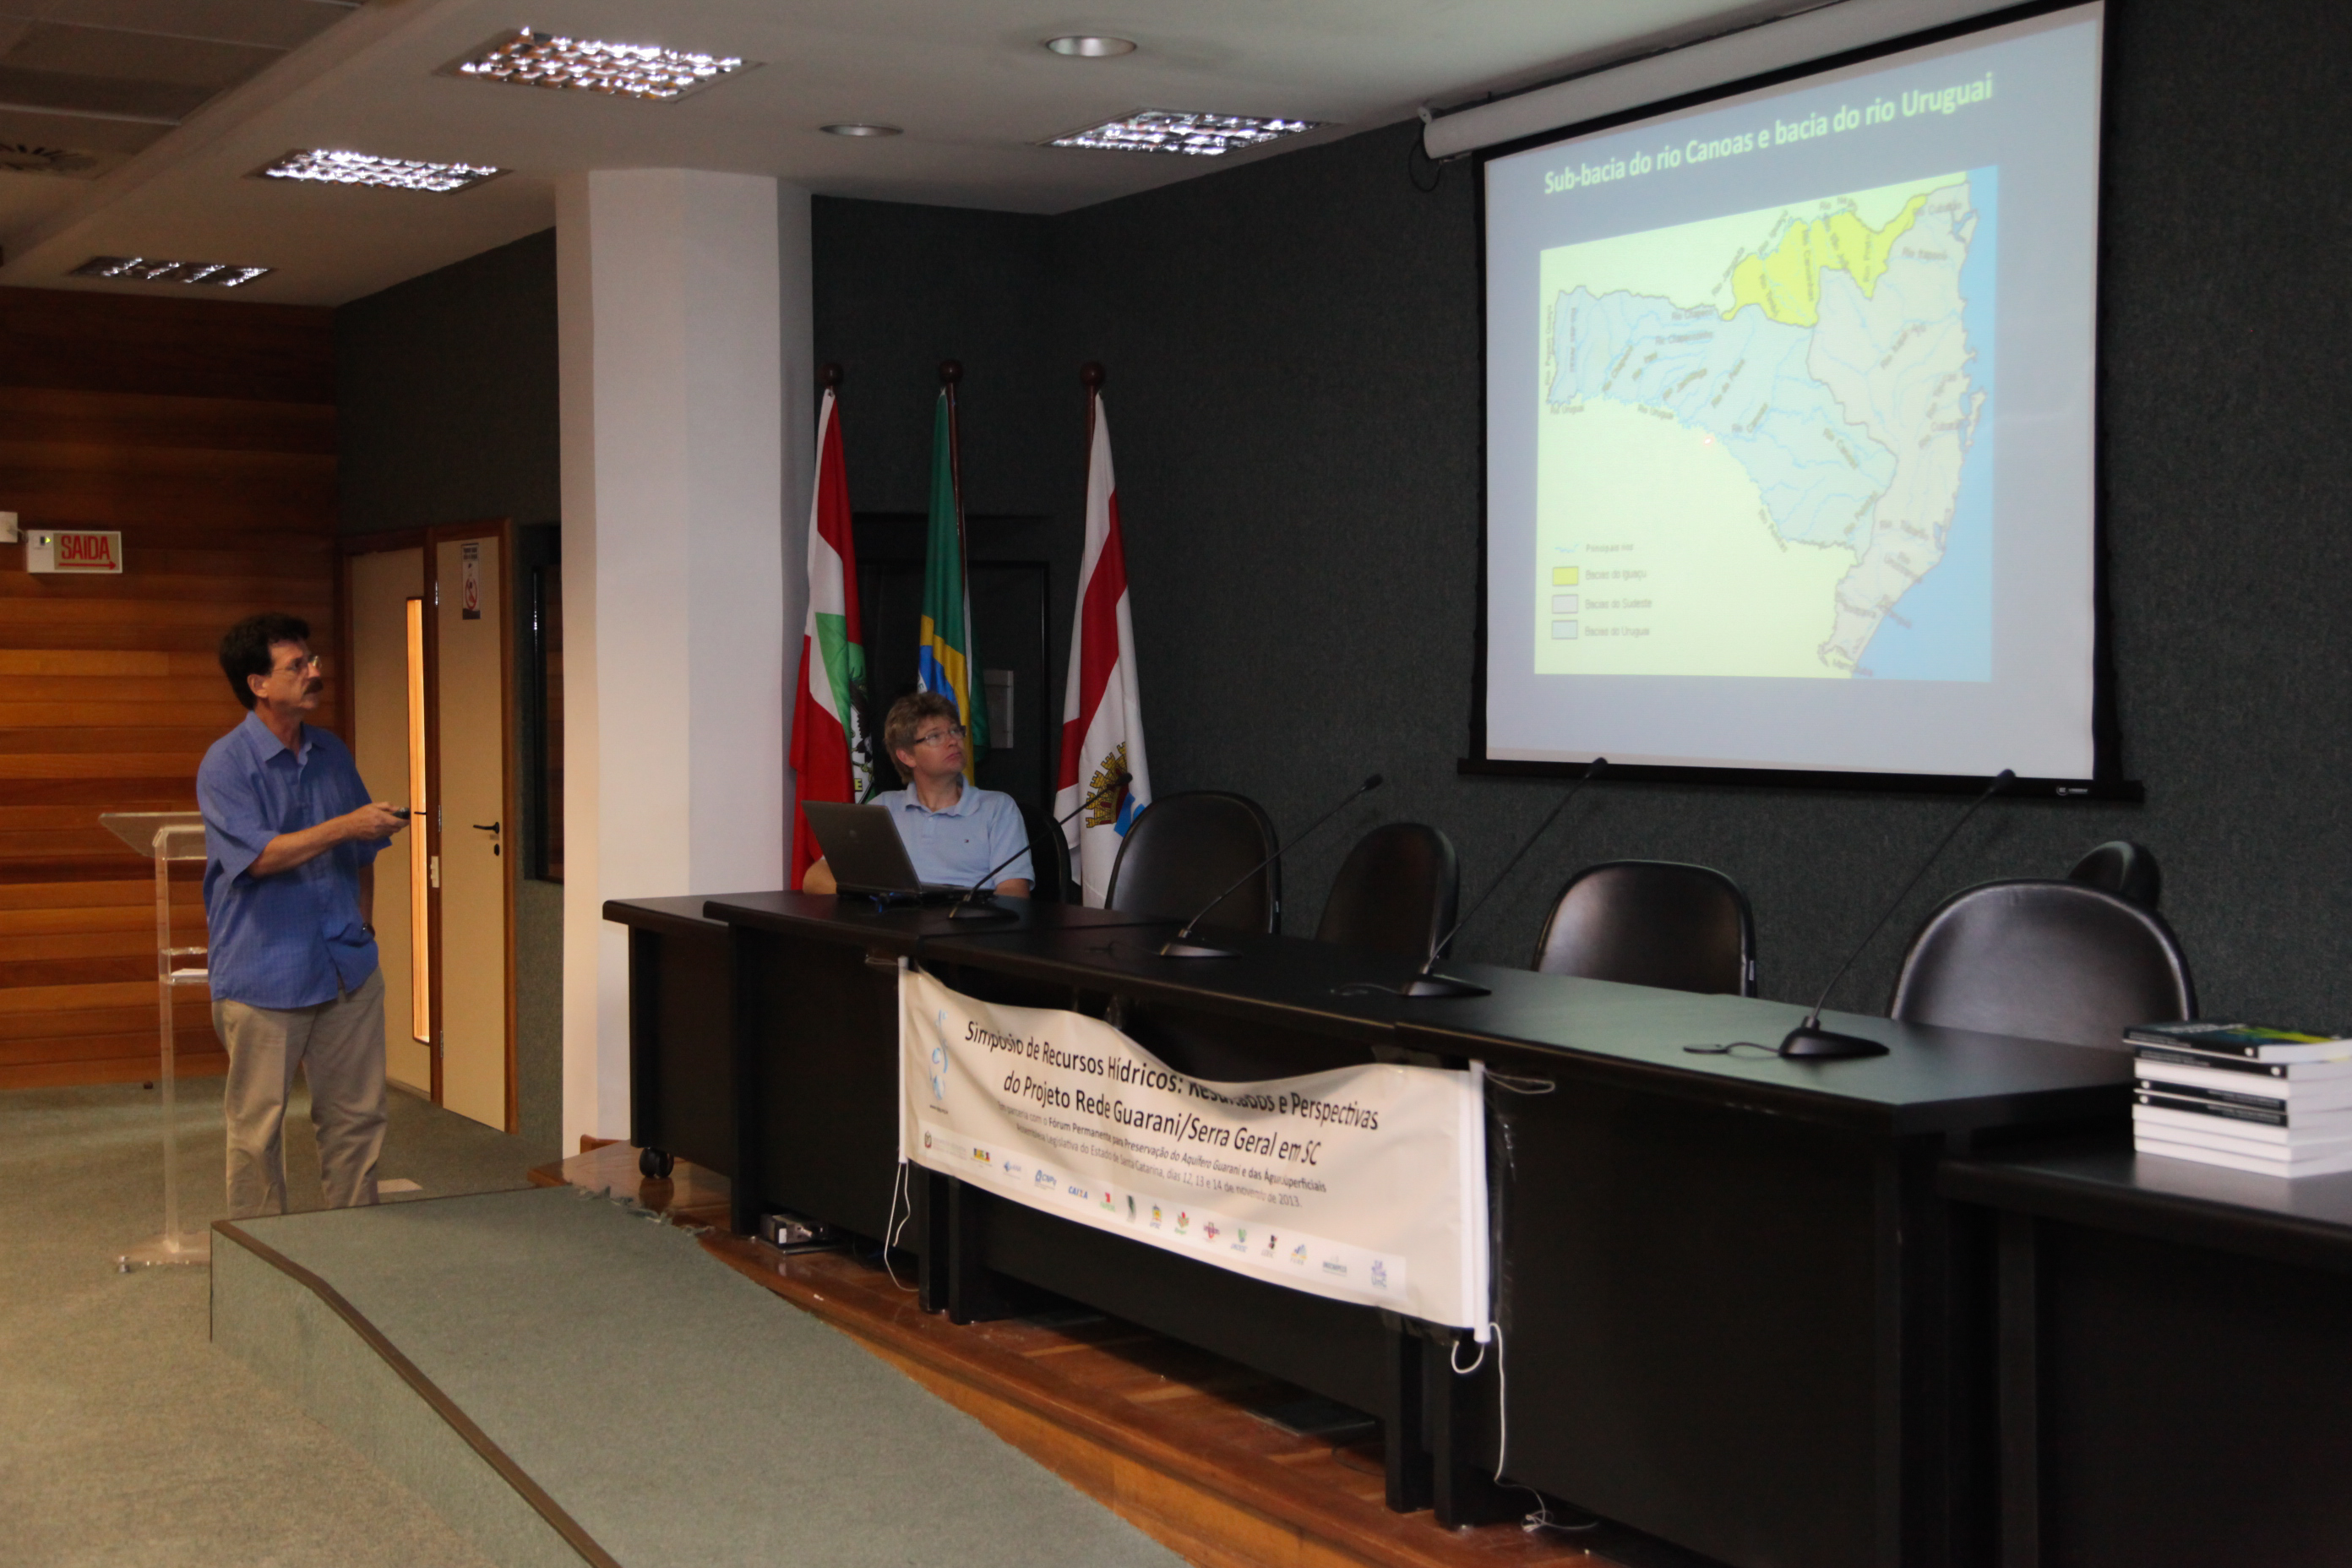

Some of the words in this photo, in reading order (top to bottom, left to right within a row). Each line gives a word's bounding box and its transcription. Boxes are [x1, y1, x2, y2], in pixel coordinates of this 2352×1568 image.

[1544, 157, 1625, 194] Sub-bacia
[1629, 151, 1652, 177] do
[1657, 145, 1681, 170] rio
[1685, 133, 1754, 164] Canoas
[1758, 128, 1770, 149] e
[1775, 112, 1828, 145] bacia
[1832, 104, 1859, 133] do
[1865, 97, 1895, 126] rio
[1902, 71, 1993, 117] Uruguai
[1004, 1070, 1020, 1093] do
[1023, 1076, 1070, 1108] Projeto
[1076, 1089, 1110, 1119] Rede
[1113, 1100, 1230, 1146] Guarani/Serra
[1234, 1127, 1277, 1157] Geral
[1278, 1141, 1301, 1162] em
[1301, 1141, 1321, 1165] SC
[1026, 1036, 1039, 1060] de
[1043, 1041, 1103, 1075] Recursos
[1108, 1056, 1184, 1093] Hídricos:
[1279, 1093, 1288, 1113] e
[1291, 1092, 1379, 1130] Perspectivas
[1048, 1117, 1070, 1131] Fórum
[1124, 1137, 1169, 1159] Preservação
[1170, 1149, 1180, 1162] do
[1213, 1159, 1240, 1175] Guarani
[1242, 1168, 1246, 1177] e
[1249, 1166, 1261, 1180] das
[1081, 1141, 1089, 1153] do
[1091, 1145, 1112, 1161] Estado
[1167, 1168, 1180, 1182] dias
[1183, 1172, 1193, 1187] 12,
[1206, 1179, 1211, 1189] e
[1213, 1179, 1222, 1191] 14
[1224, 1182, 1234, 1193] de
[1279, 1193, 1302, 1207] 2013.
[1068, 1186, 1088, 1200] CAIXA
